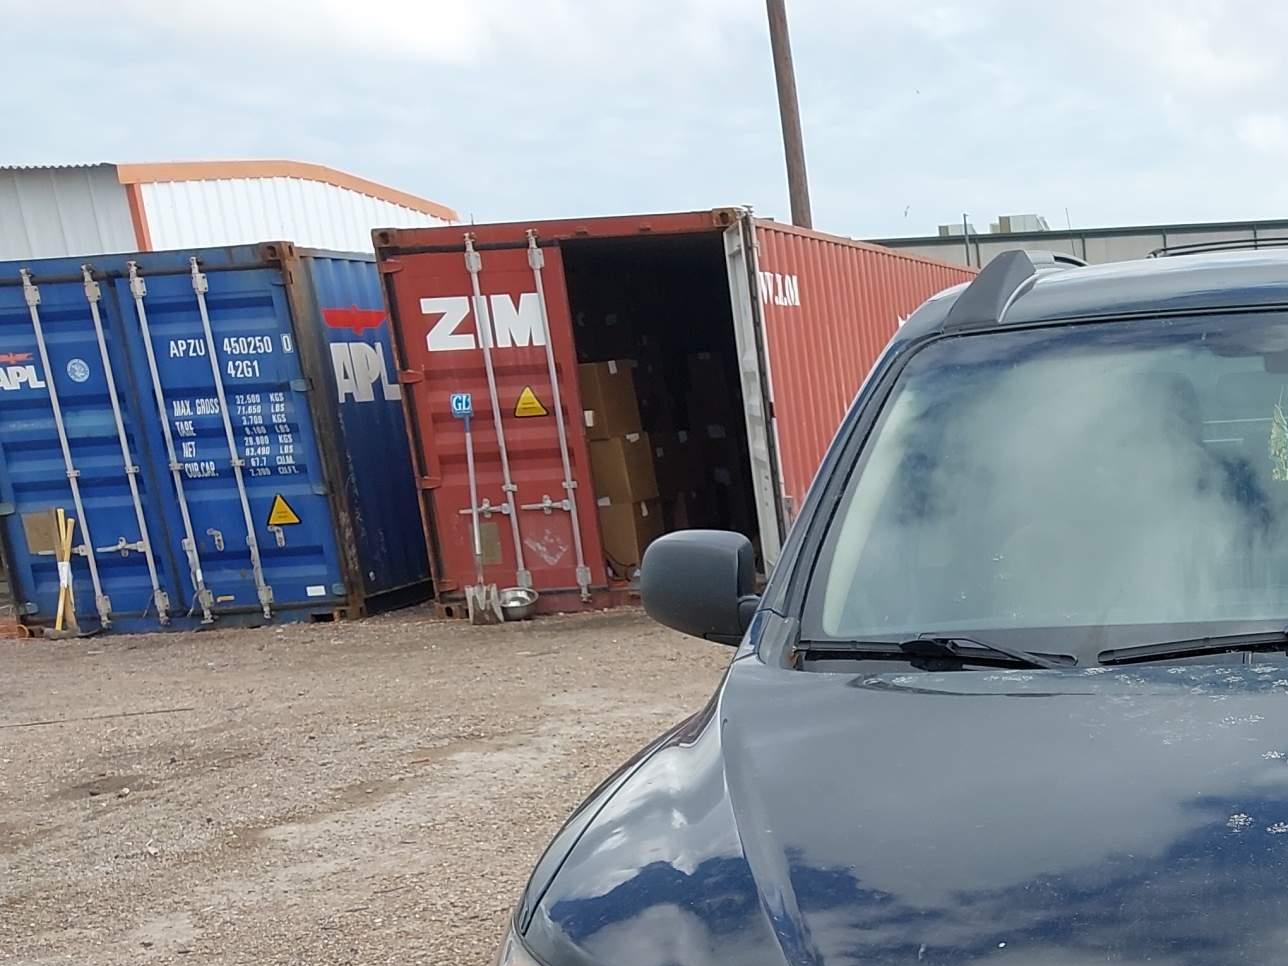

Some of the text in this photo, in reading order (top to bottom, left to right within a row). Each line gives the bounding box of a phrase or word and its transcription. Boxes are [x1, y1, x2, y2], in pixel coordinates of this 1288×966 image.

[420, 292, 546, 351] ZIM
[169, 338, 206, 358] APZU
[223, 336, 273, 354] 450250
[227, 360, 260, 378] 42G1
[329, 342, 402, 404] APL
[172, 399, 194, 417] MAX.
[195, 398, 220, 416] GROSS
[182, 441, 196, 459] NET
